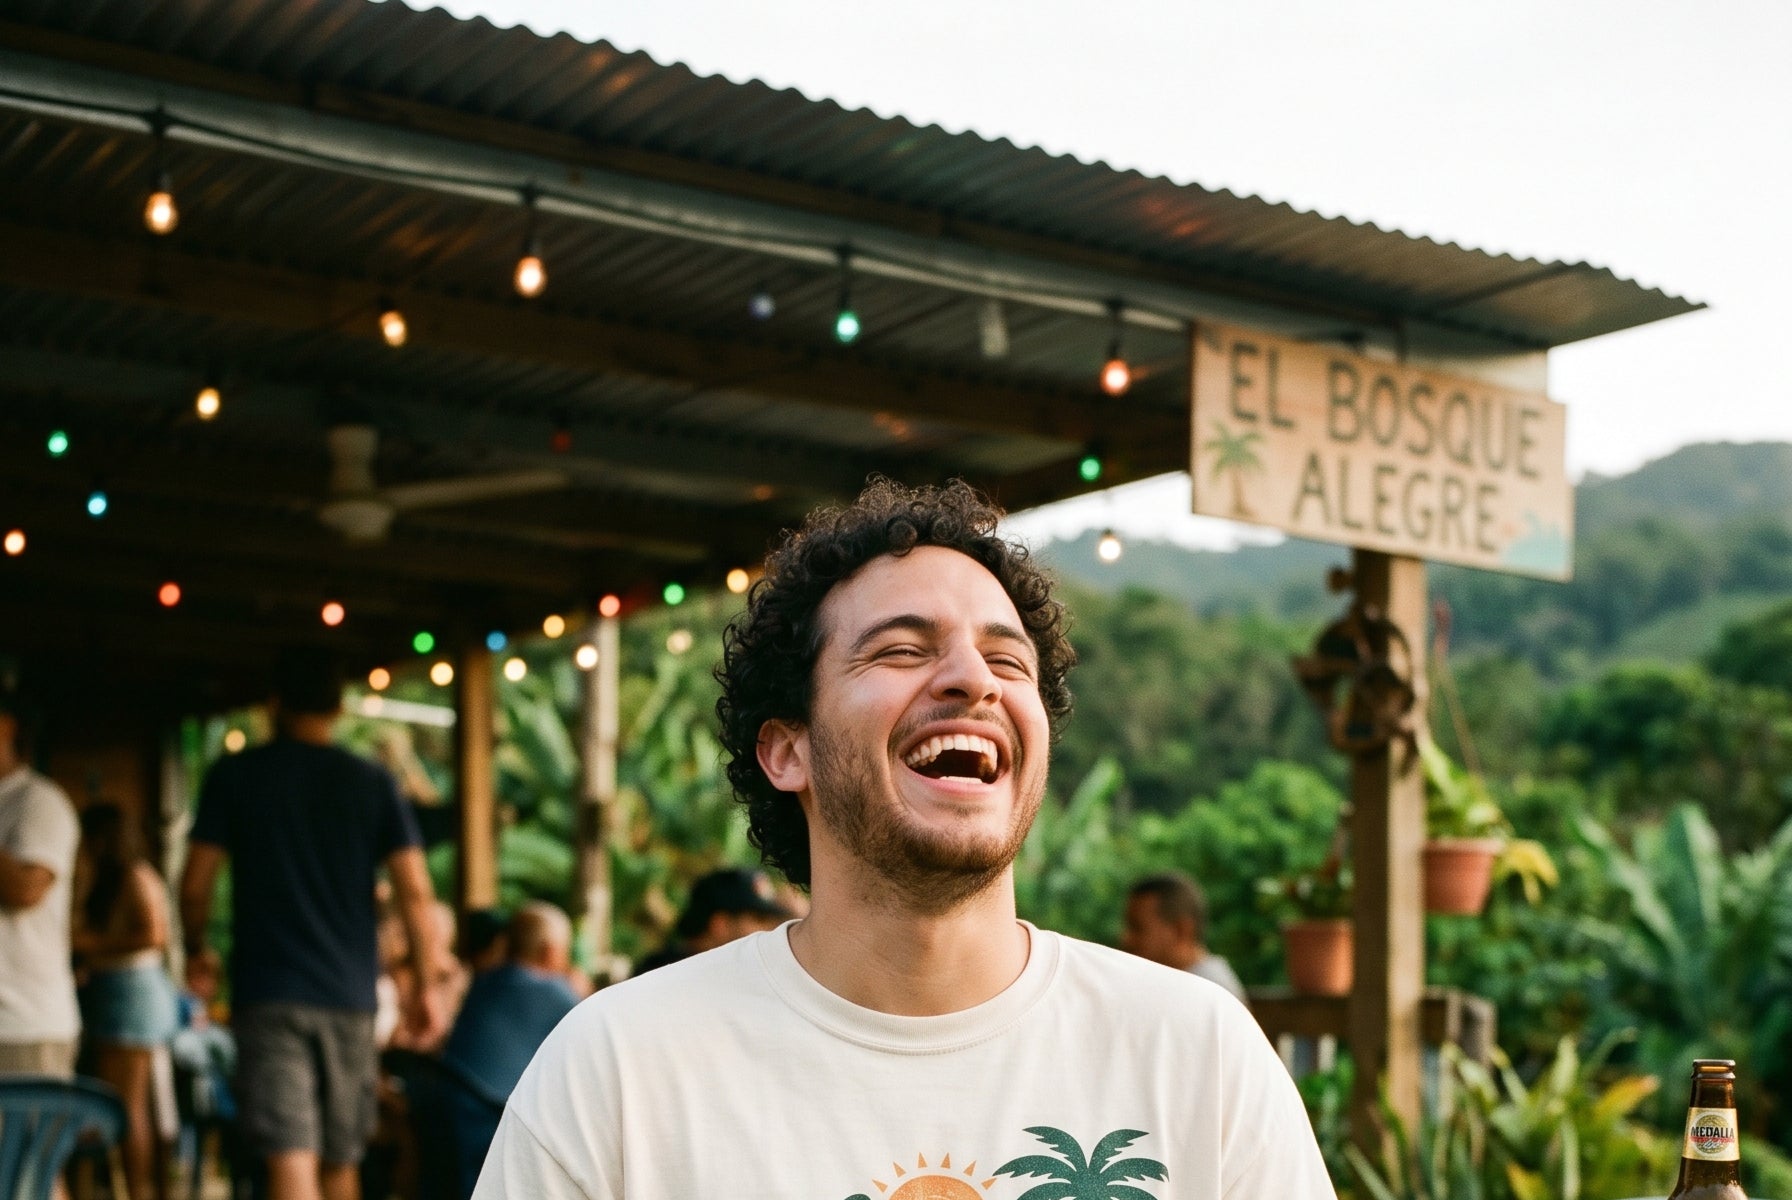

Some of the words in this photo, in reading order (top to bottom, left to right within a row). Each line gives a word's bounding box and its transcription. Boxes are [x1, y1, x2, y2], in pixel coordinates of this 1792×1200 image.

[1230, 340, 1295, 430] EL
[1327, 359, 1545, 481] BOSQUE
[1292, 450, 1501, 554] ALEGRE
[1690, 1126, 1735, 1139] MEDALLA
